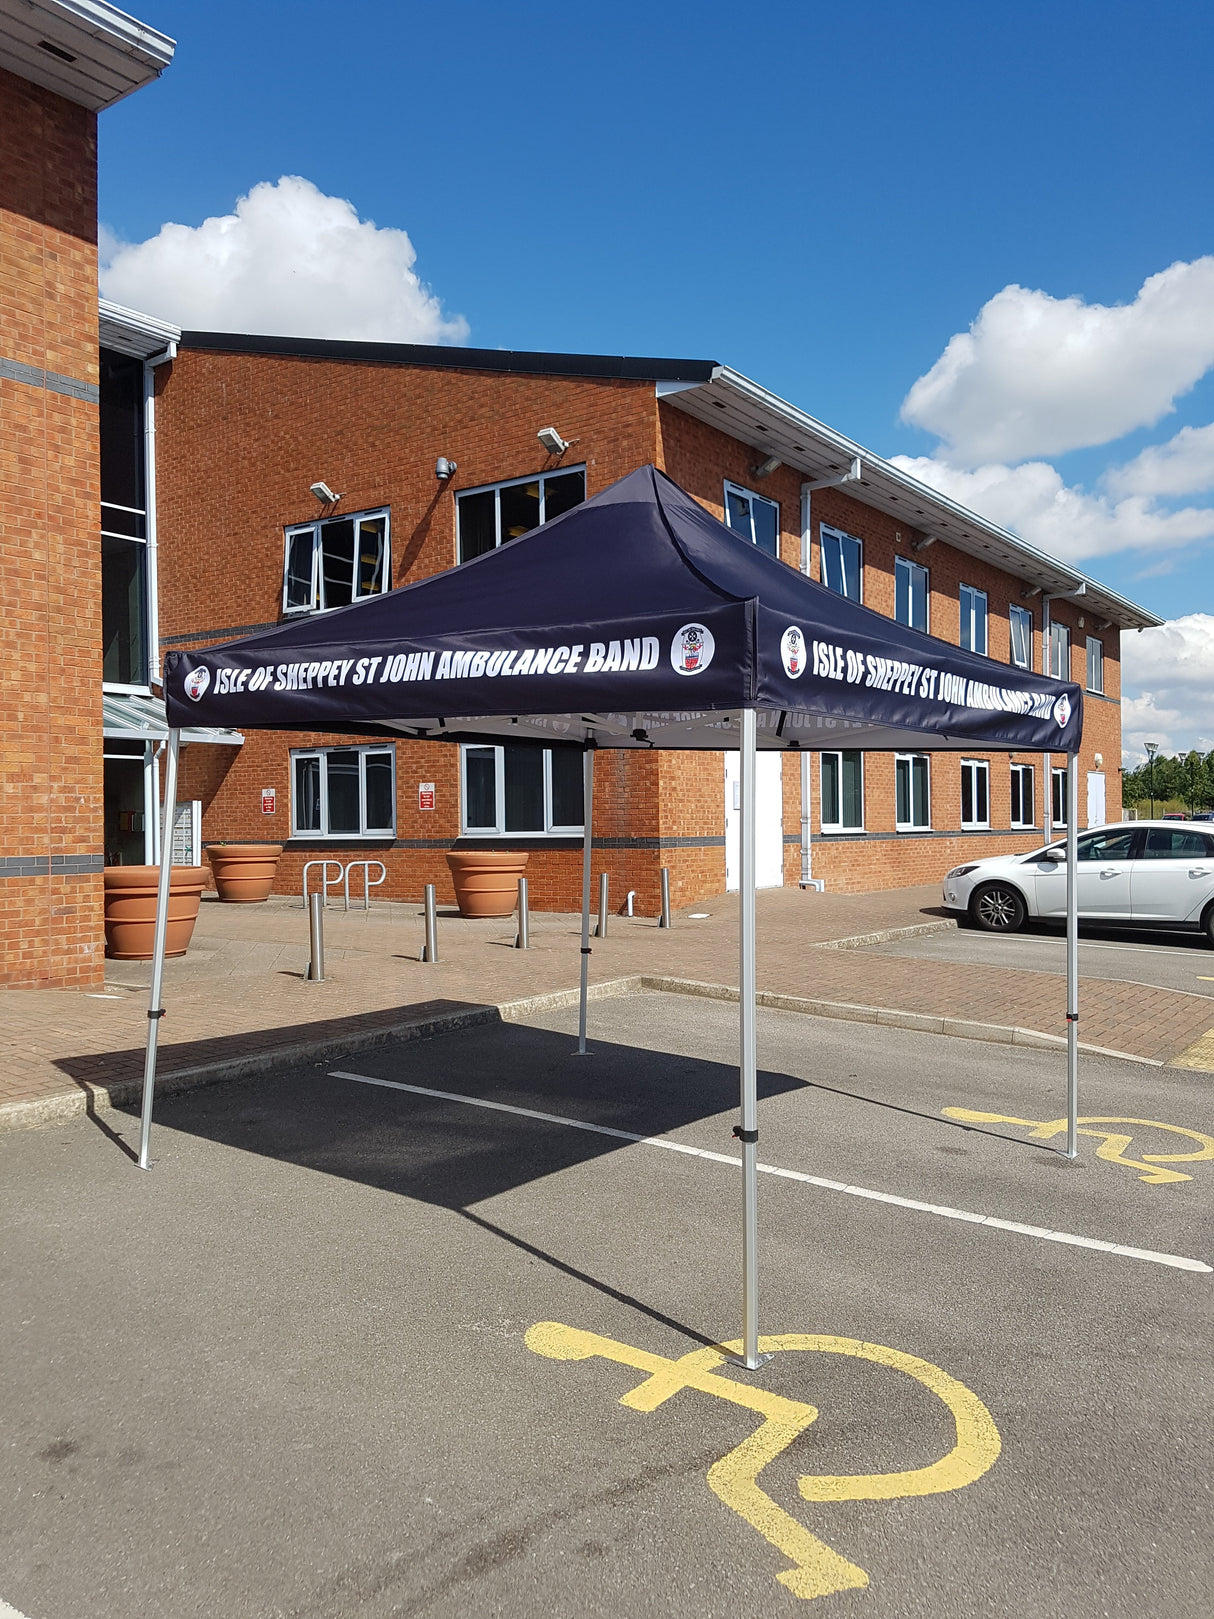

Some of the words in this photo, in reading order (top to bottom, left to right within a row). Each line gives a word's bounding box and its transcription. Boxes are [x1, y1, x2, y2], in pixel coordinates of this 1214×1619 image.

[213, 668, 252, 694] ISLE
[248, 666, 274, 691] OF
[274, 659, 355, 691] SHEPPEY
[353, 657, 382, 686] ST
[380, 651, 436, 683] JOHN
[435, 645, 583, 680] AMBULANCE
[583, 637, 659, 673] BAND
[813, 640, 844, 681] ISLE
[846, 649, 865, 685] OF
[866, 654, 923, 696] SHEPPEY
[919, 667, 938, 700] ST
[938, 672, 967, 707] JOHN
[966, 679, 1032, 715] AMBULANCE
